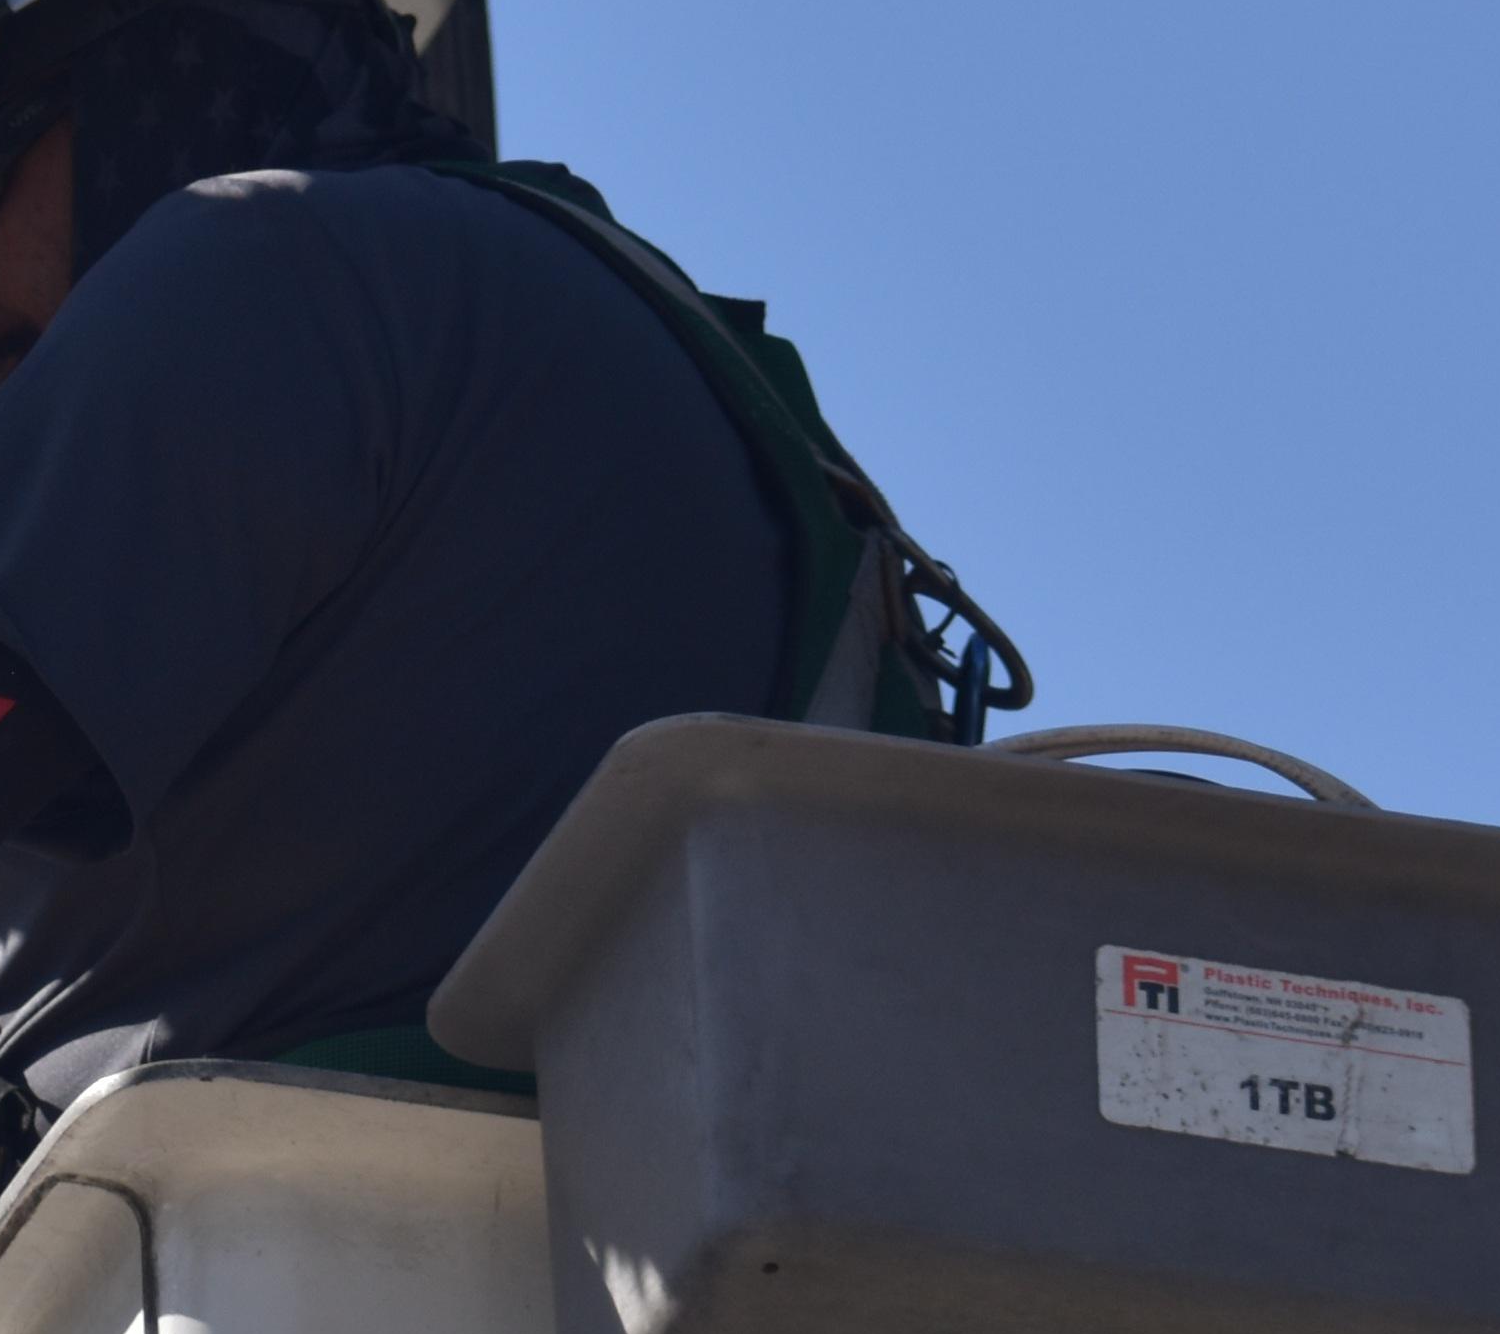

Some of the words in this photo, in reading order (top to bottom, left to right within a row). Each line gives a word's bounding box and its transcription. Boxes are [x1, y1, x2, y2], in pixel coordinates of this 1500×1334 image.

[1122, 955, 1180, 1014] PTI
[1204, 967, 1273, 989] Plastic
[1279, 978, 1401, 1011] Techniques,
[1405, 997, 1445, 1017] Inc.
[1204, 1011, 1360, 1042] www.PlasticTechniques.cm
[1239, 1074, 1337, 1122] 1TB
